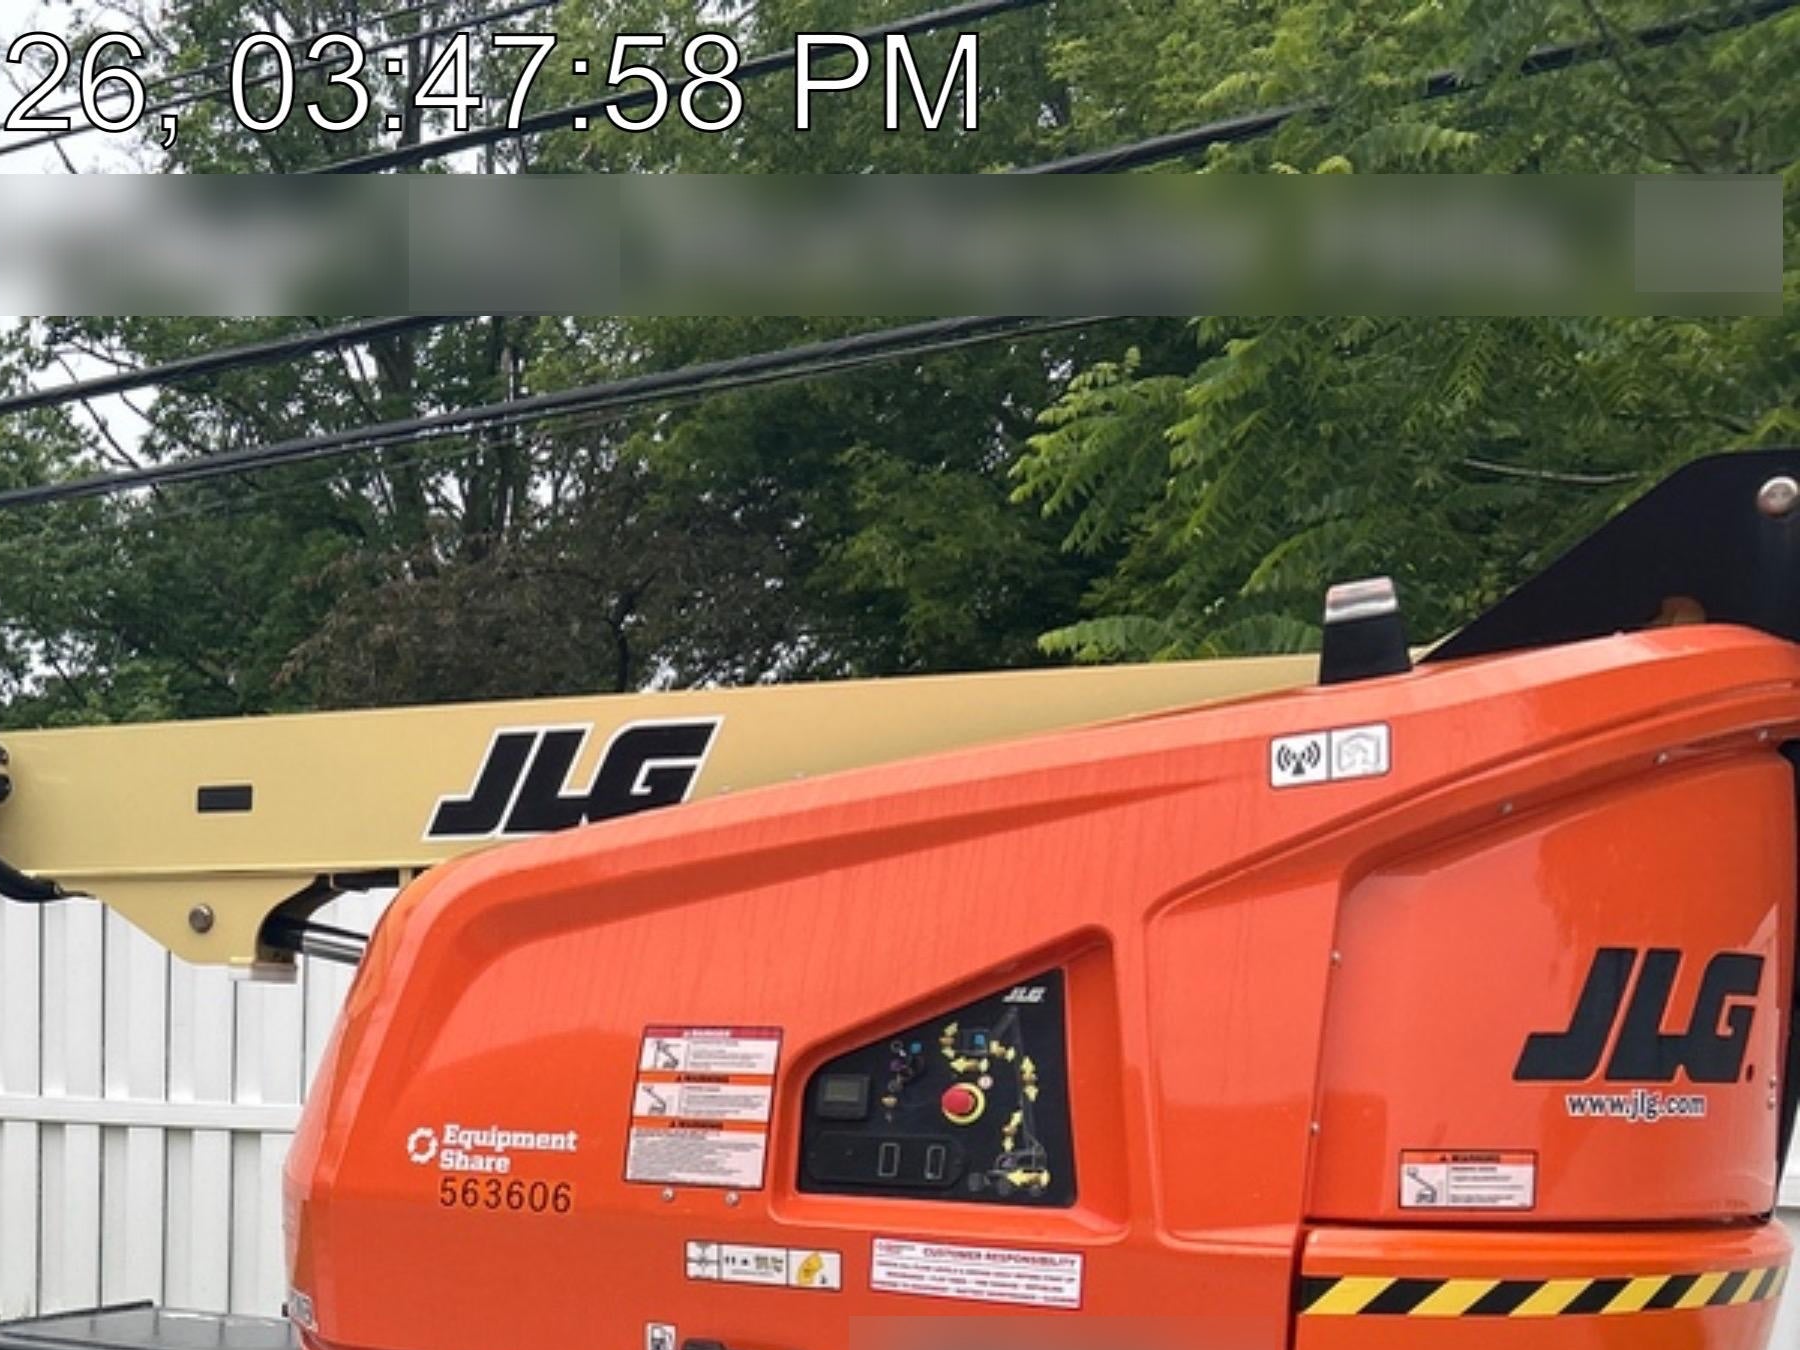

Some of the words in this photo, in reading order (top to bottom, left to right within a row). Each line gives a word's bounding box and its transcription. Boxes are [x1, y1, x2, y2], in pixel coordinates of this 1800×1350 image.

[424, 717, 722, 838] JLG
[1003, 986, 1048, 1003] JLG
[1512, 947, 1766, 1083] JLG
[1566, 1089, 1706, 1121] www.jlg.com
[443, 1123, 578, 1152] Equipment
[439, 1148, 511, 1174] Share
[439, 1176, 571, 1213] 563606
